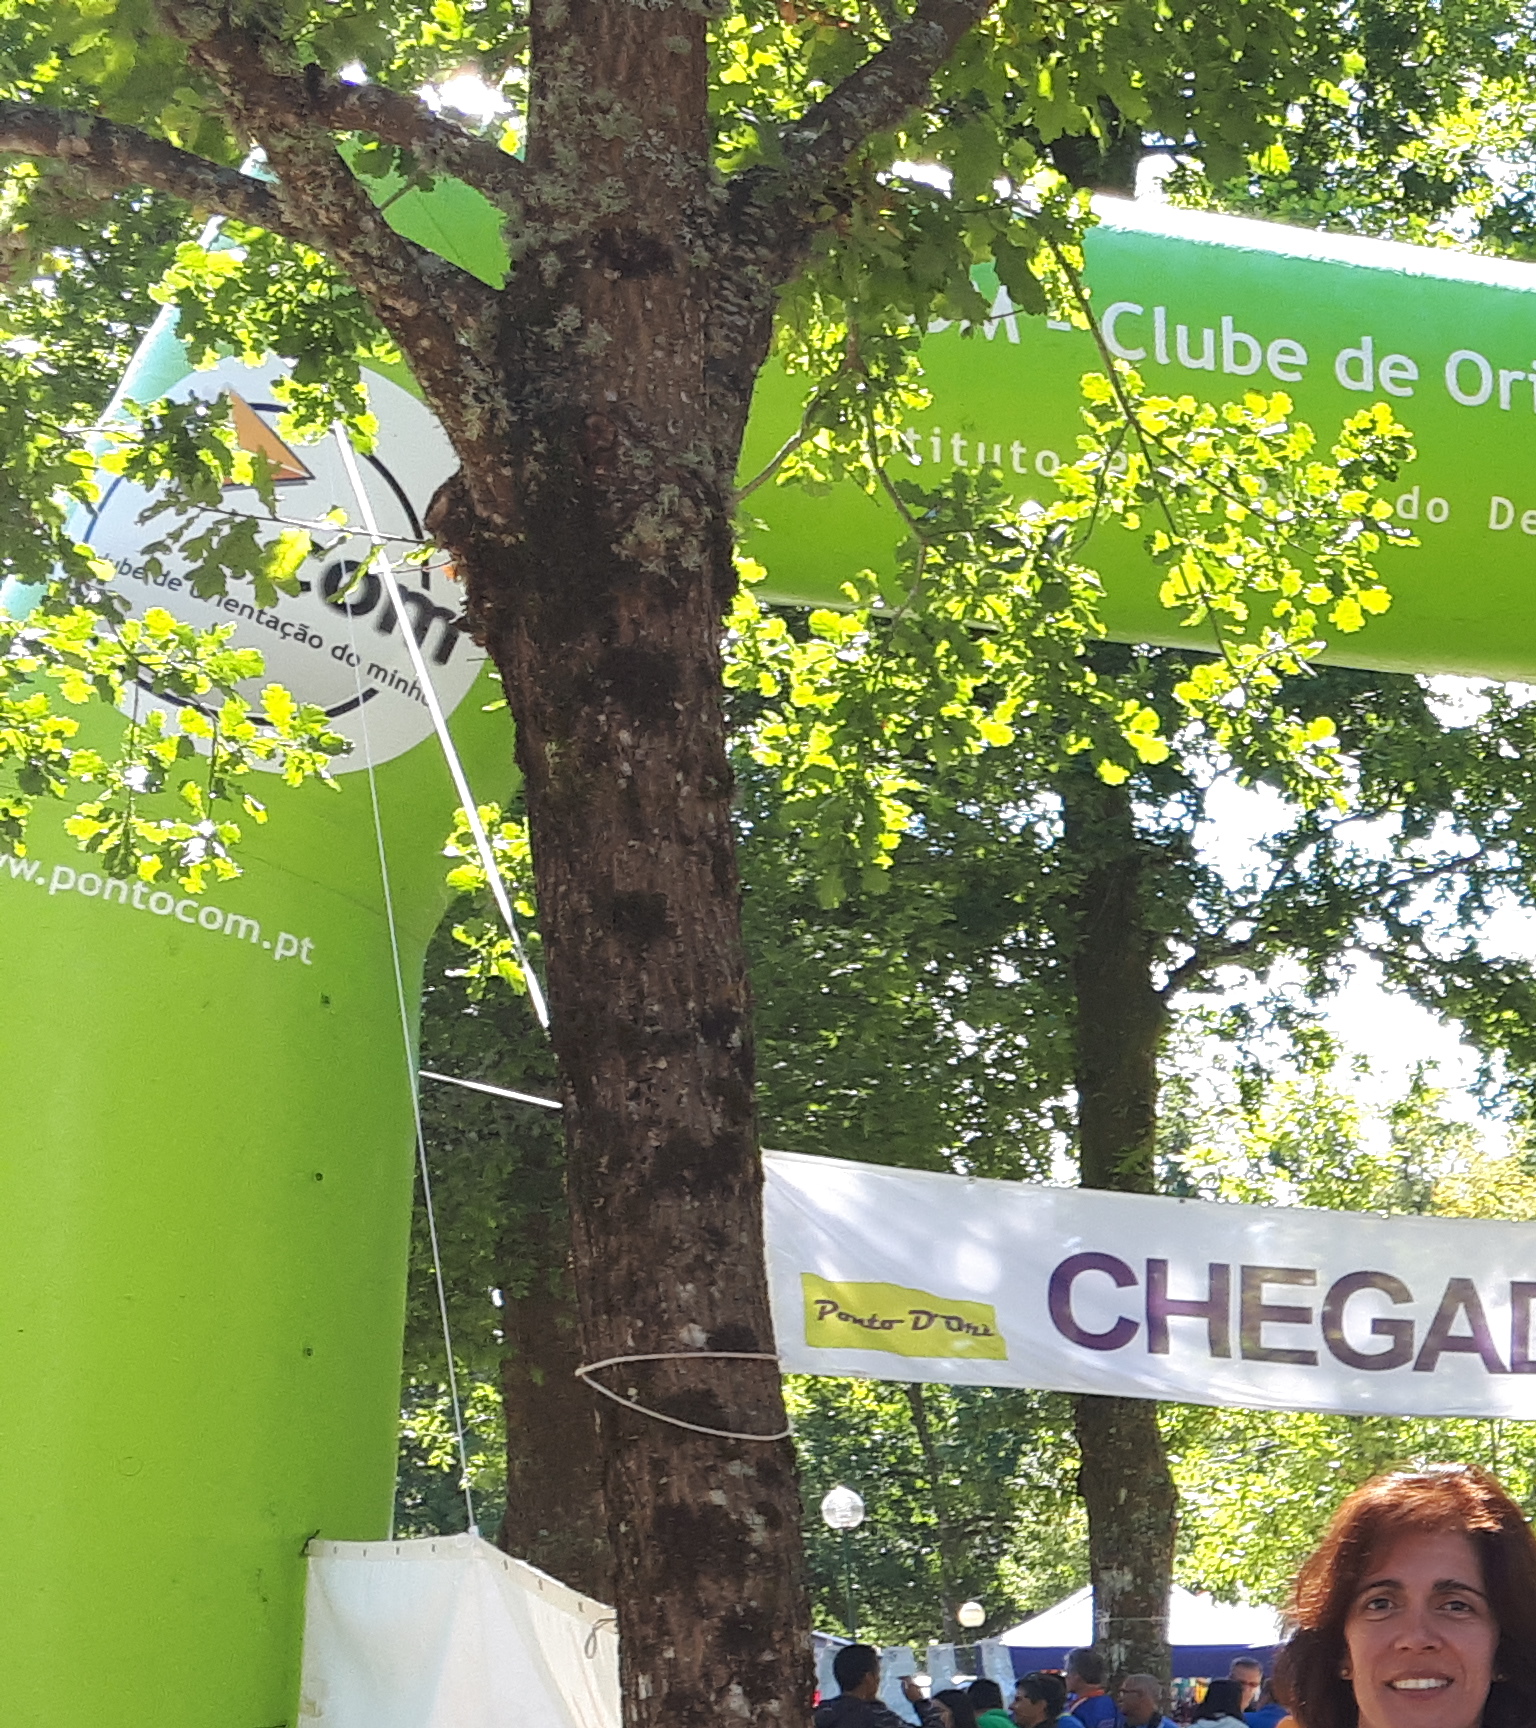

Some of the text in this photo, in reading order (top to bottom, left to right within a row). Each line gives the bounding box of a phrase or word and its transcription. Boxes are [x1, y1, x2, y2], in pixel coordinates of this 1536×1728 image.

[1101, 301, 1308, 384] Clube
[1334, 335, 1420, 399] de
[1395, 485, 1450, 524] do
[331, 643, 361, 668] do
[814, 1299, 904, 1331] Ponto
